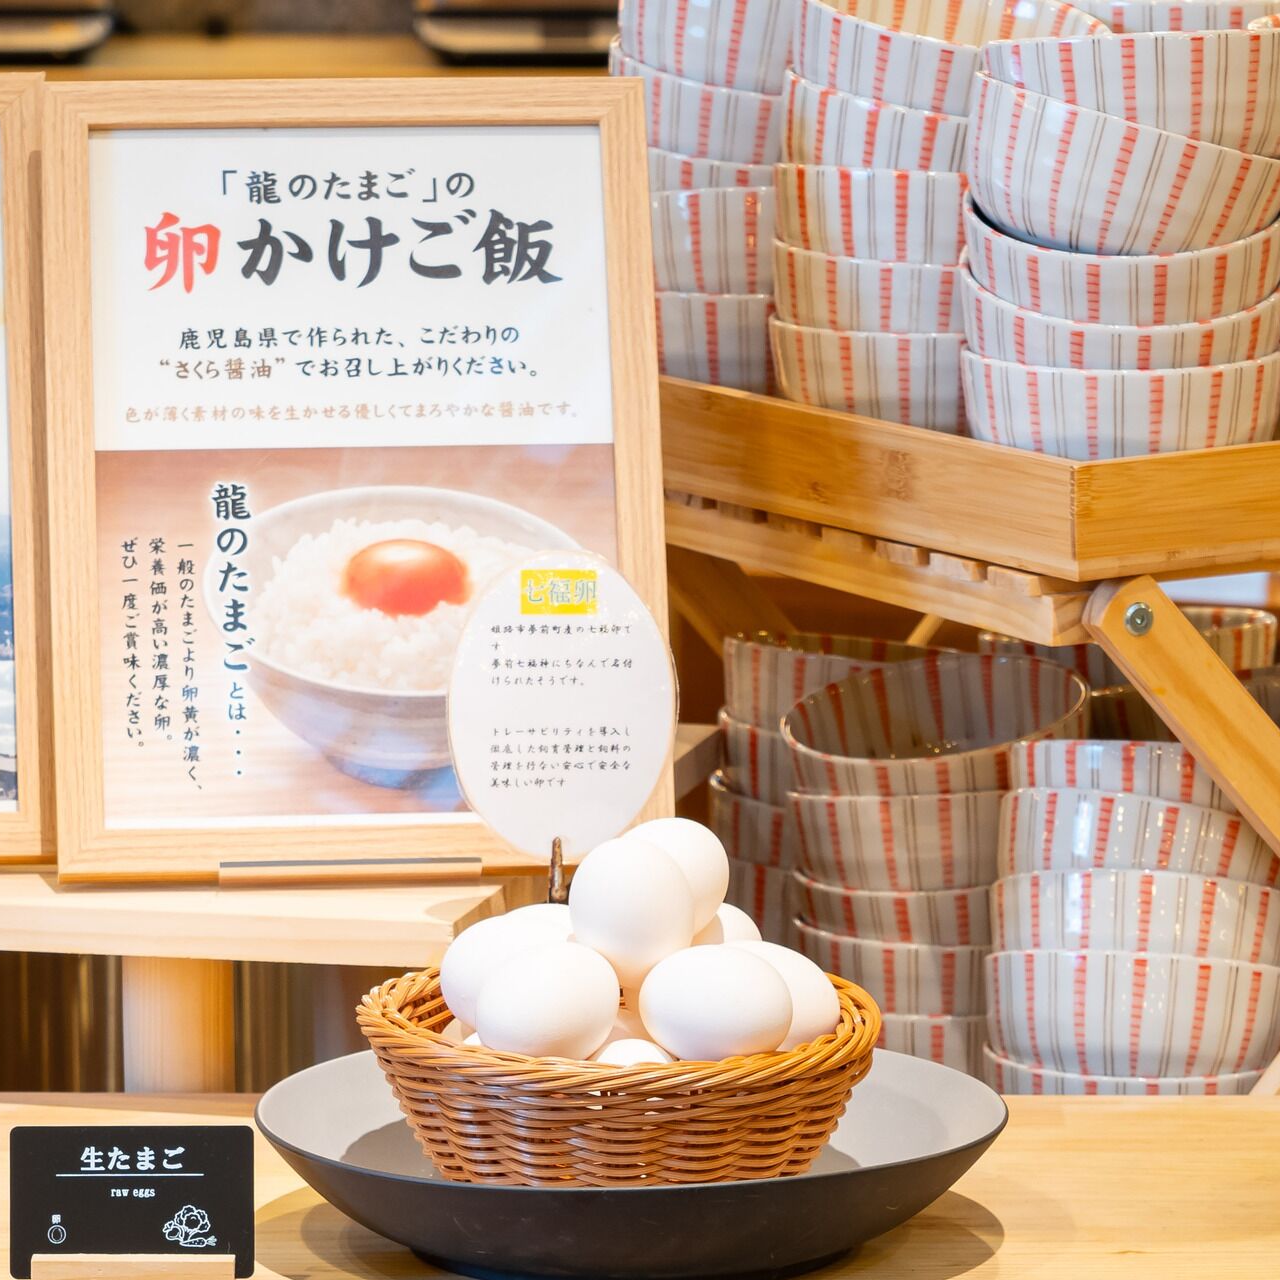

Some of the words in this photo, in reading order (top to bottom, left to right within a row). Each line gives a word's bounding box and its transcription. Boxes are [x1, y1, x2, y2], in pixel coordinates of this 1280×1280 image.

[220, 168, 475, 204] 「龍のたまご」の
[144, 208, 564, 294] 卵かけご飯
[179, 325, 520, 351] 鹿児島県で作られた、こだわりの
[525, 578, 598, 604] 七福卵
[121, 537, 144, 748] ぜひ一度ご賞味ください。
[149, 537, 173, 741] 栄養価が高い濃厚な卵。
[177, 541, 202, 790] 一般のたまごより卵黄が濃く、
[490, 777, 567, 789] 美味しい卵です
[80, 1146, 186, 1171] 生たまご
[110, 1188, 130, 1198] raw
[132, 1188, 156, 1199] eggs
